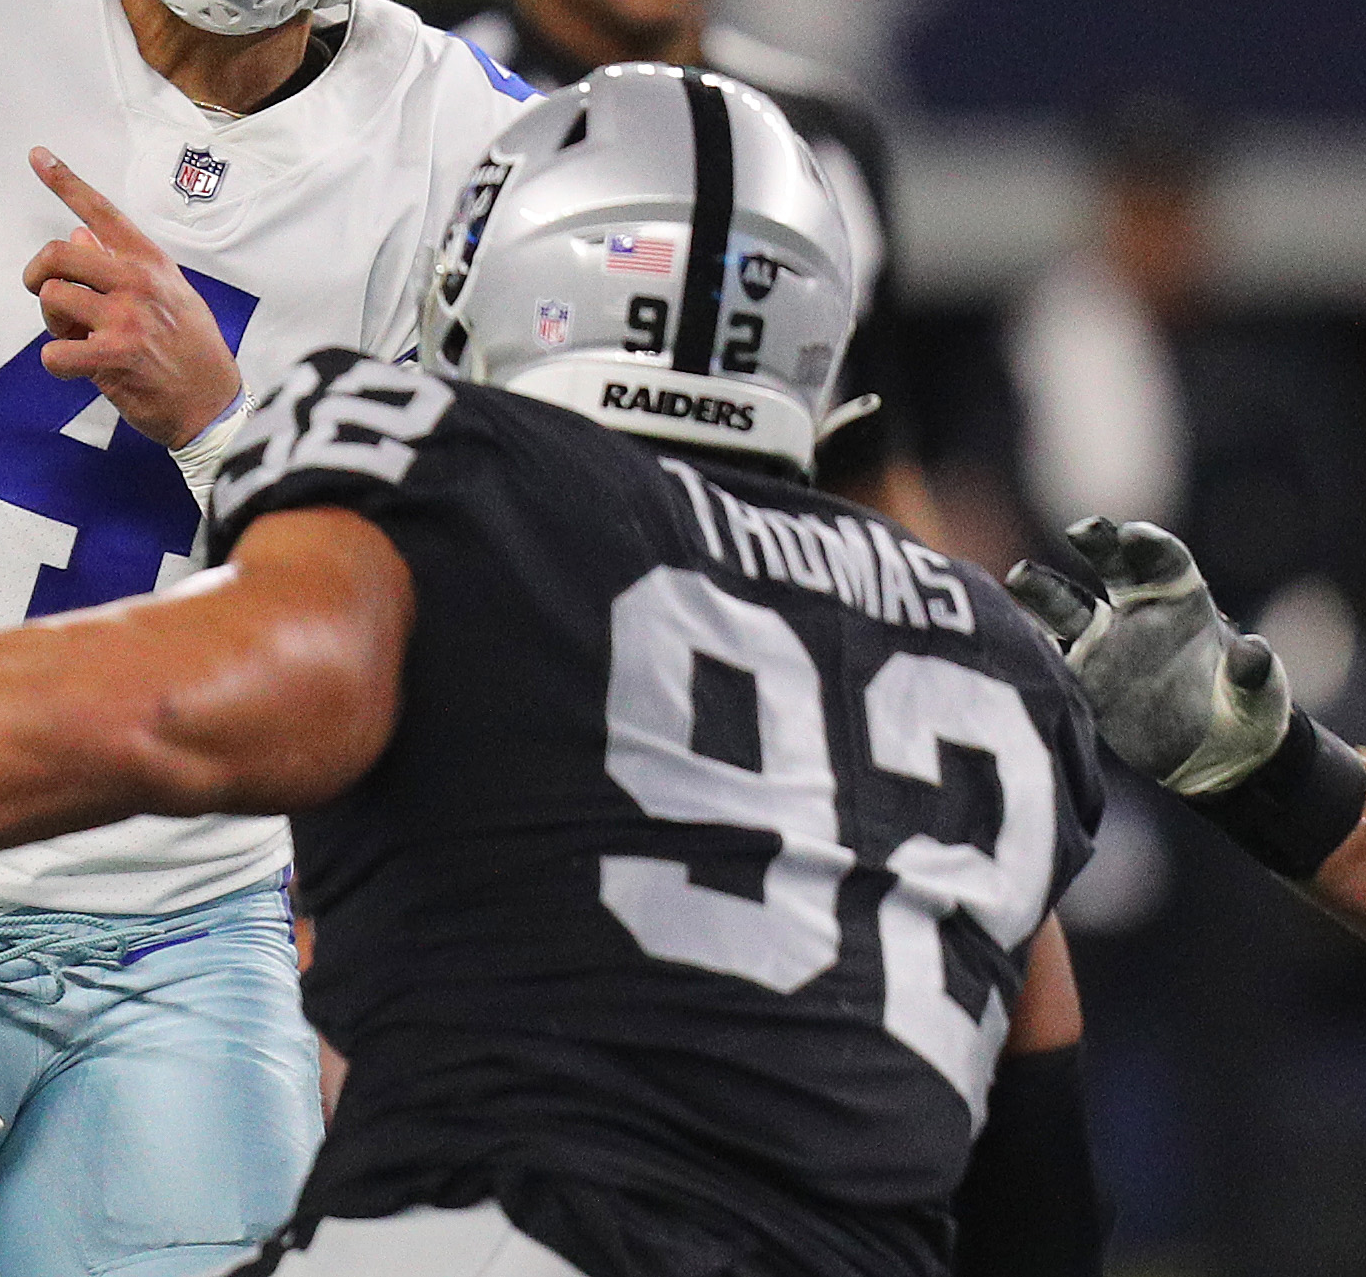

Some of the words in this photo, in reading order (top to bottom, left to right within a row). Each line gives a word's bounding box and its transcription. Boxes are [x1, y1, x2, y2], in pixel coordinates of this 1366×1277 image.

[179, 166, 212, 193] NFL
[602, 382, 755, 431] RAIDERS
[657, 455, 976, 635] THOMAS
[599, 564, 1057, 1140] 92
